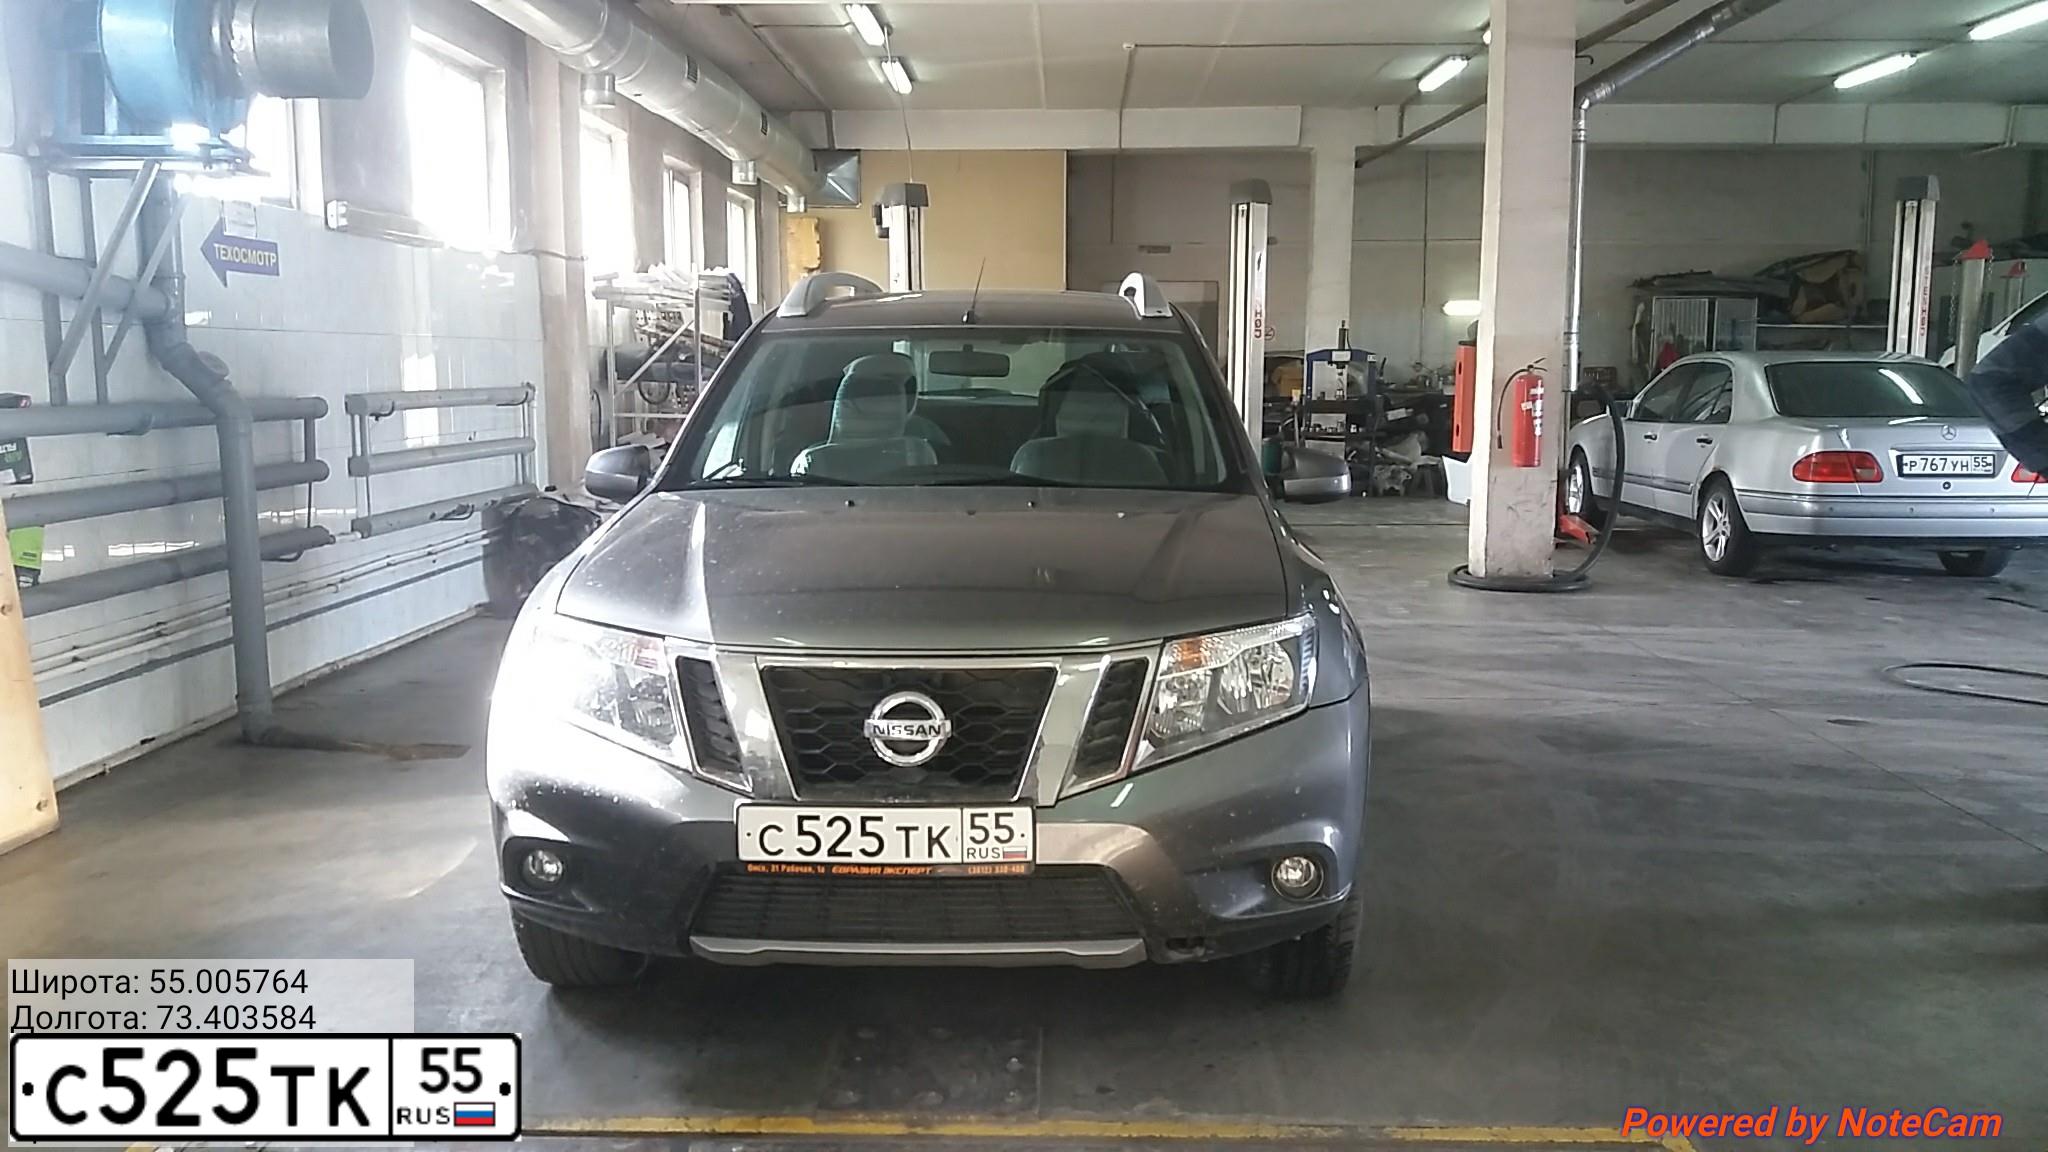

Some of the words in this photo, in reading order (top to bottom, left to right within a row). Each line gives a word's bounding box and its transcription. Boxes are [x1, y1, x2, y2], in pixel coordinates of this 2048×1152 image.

[213, 243, 277, 267] ТЕХОСМОТР
[1973, 457, 1988, 468] 55
[872, 724, 941, 736] NISSAN
[969, 812, 1015, 844] 55
[966, 847, 1001, 860] RUS
